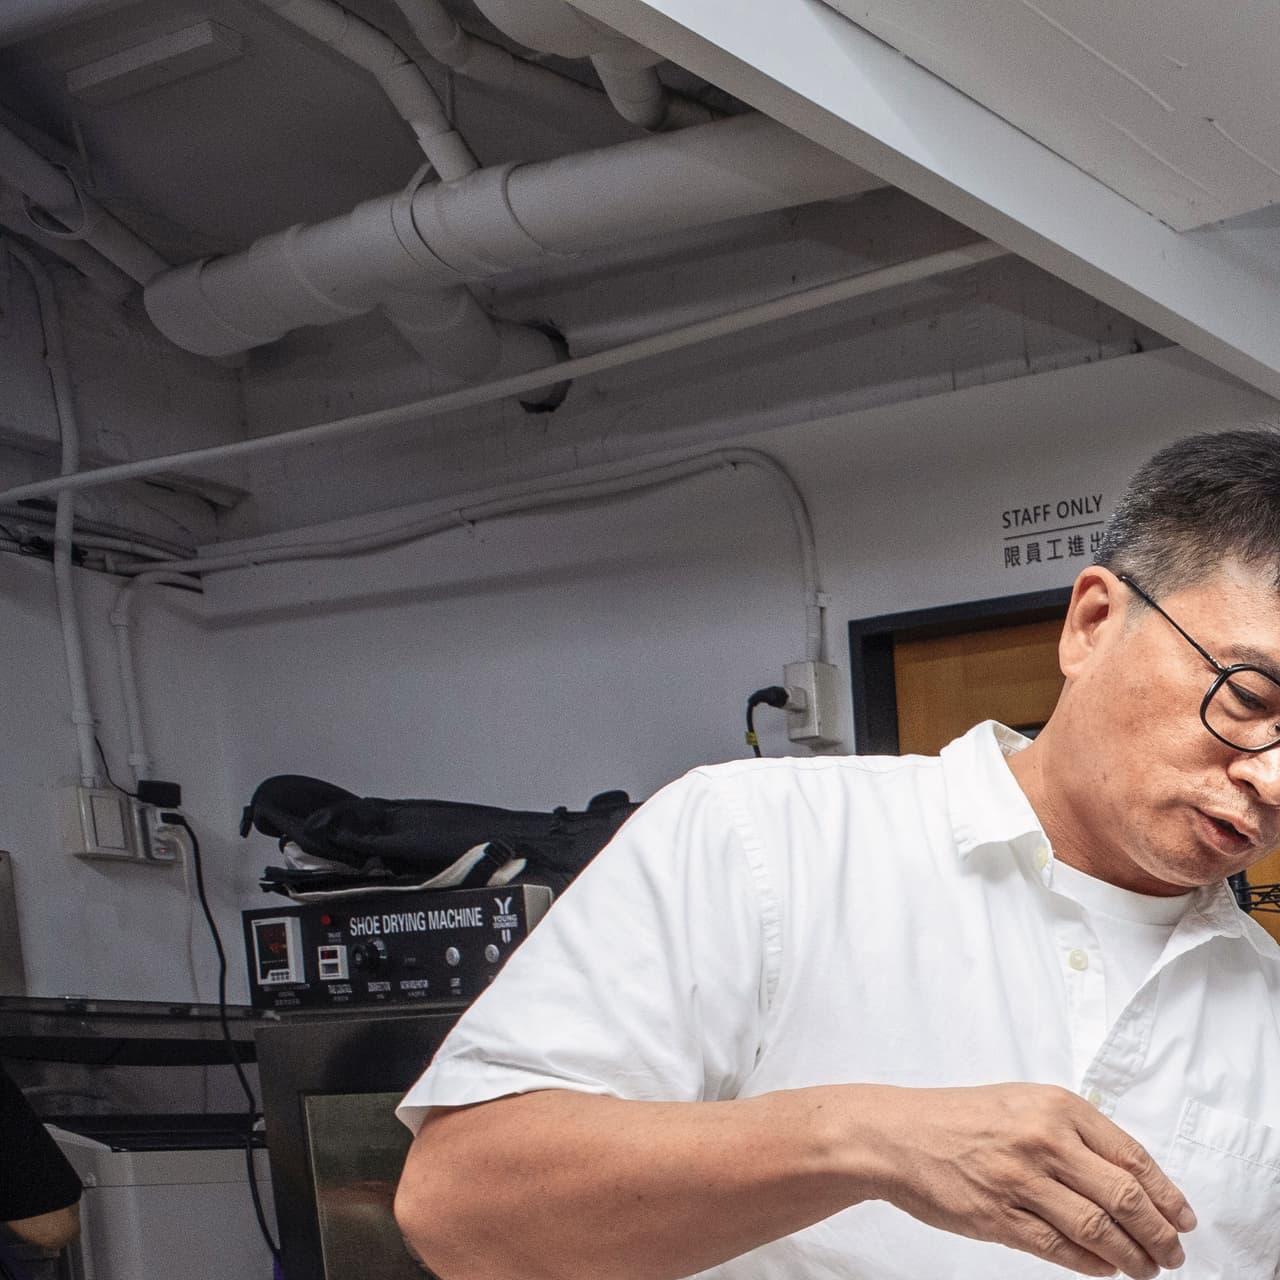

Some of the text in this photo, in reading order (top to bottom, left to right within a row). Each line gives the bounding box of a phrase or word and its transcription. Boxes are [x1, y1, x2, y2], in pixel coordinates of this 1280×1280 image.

[1002, 494, 1103, 529] STAFF ONLY
[350, 907, 483, 936] SHOE DRYING MACHINE
